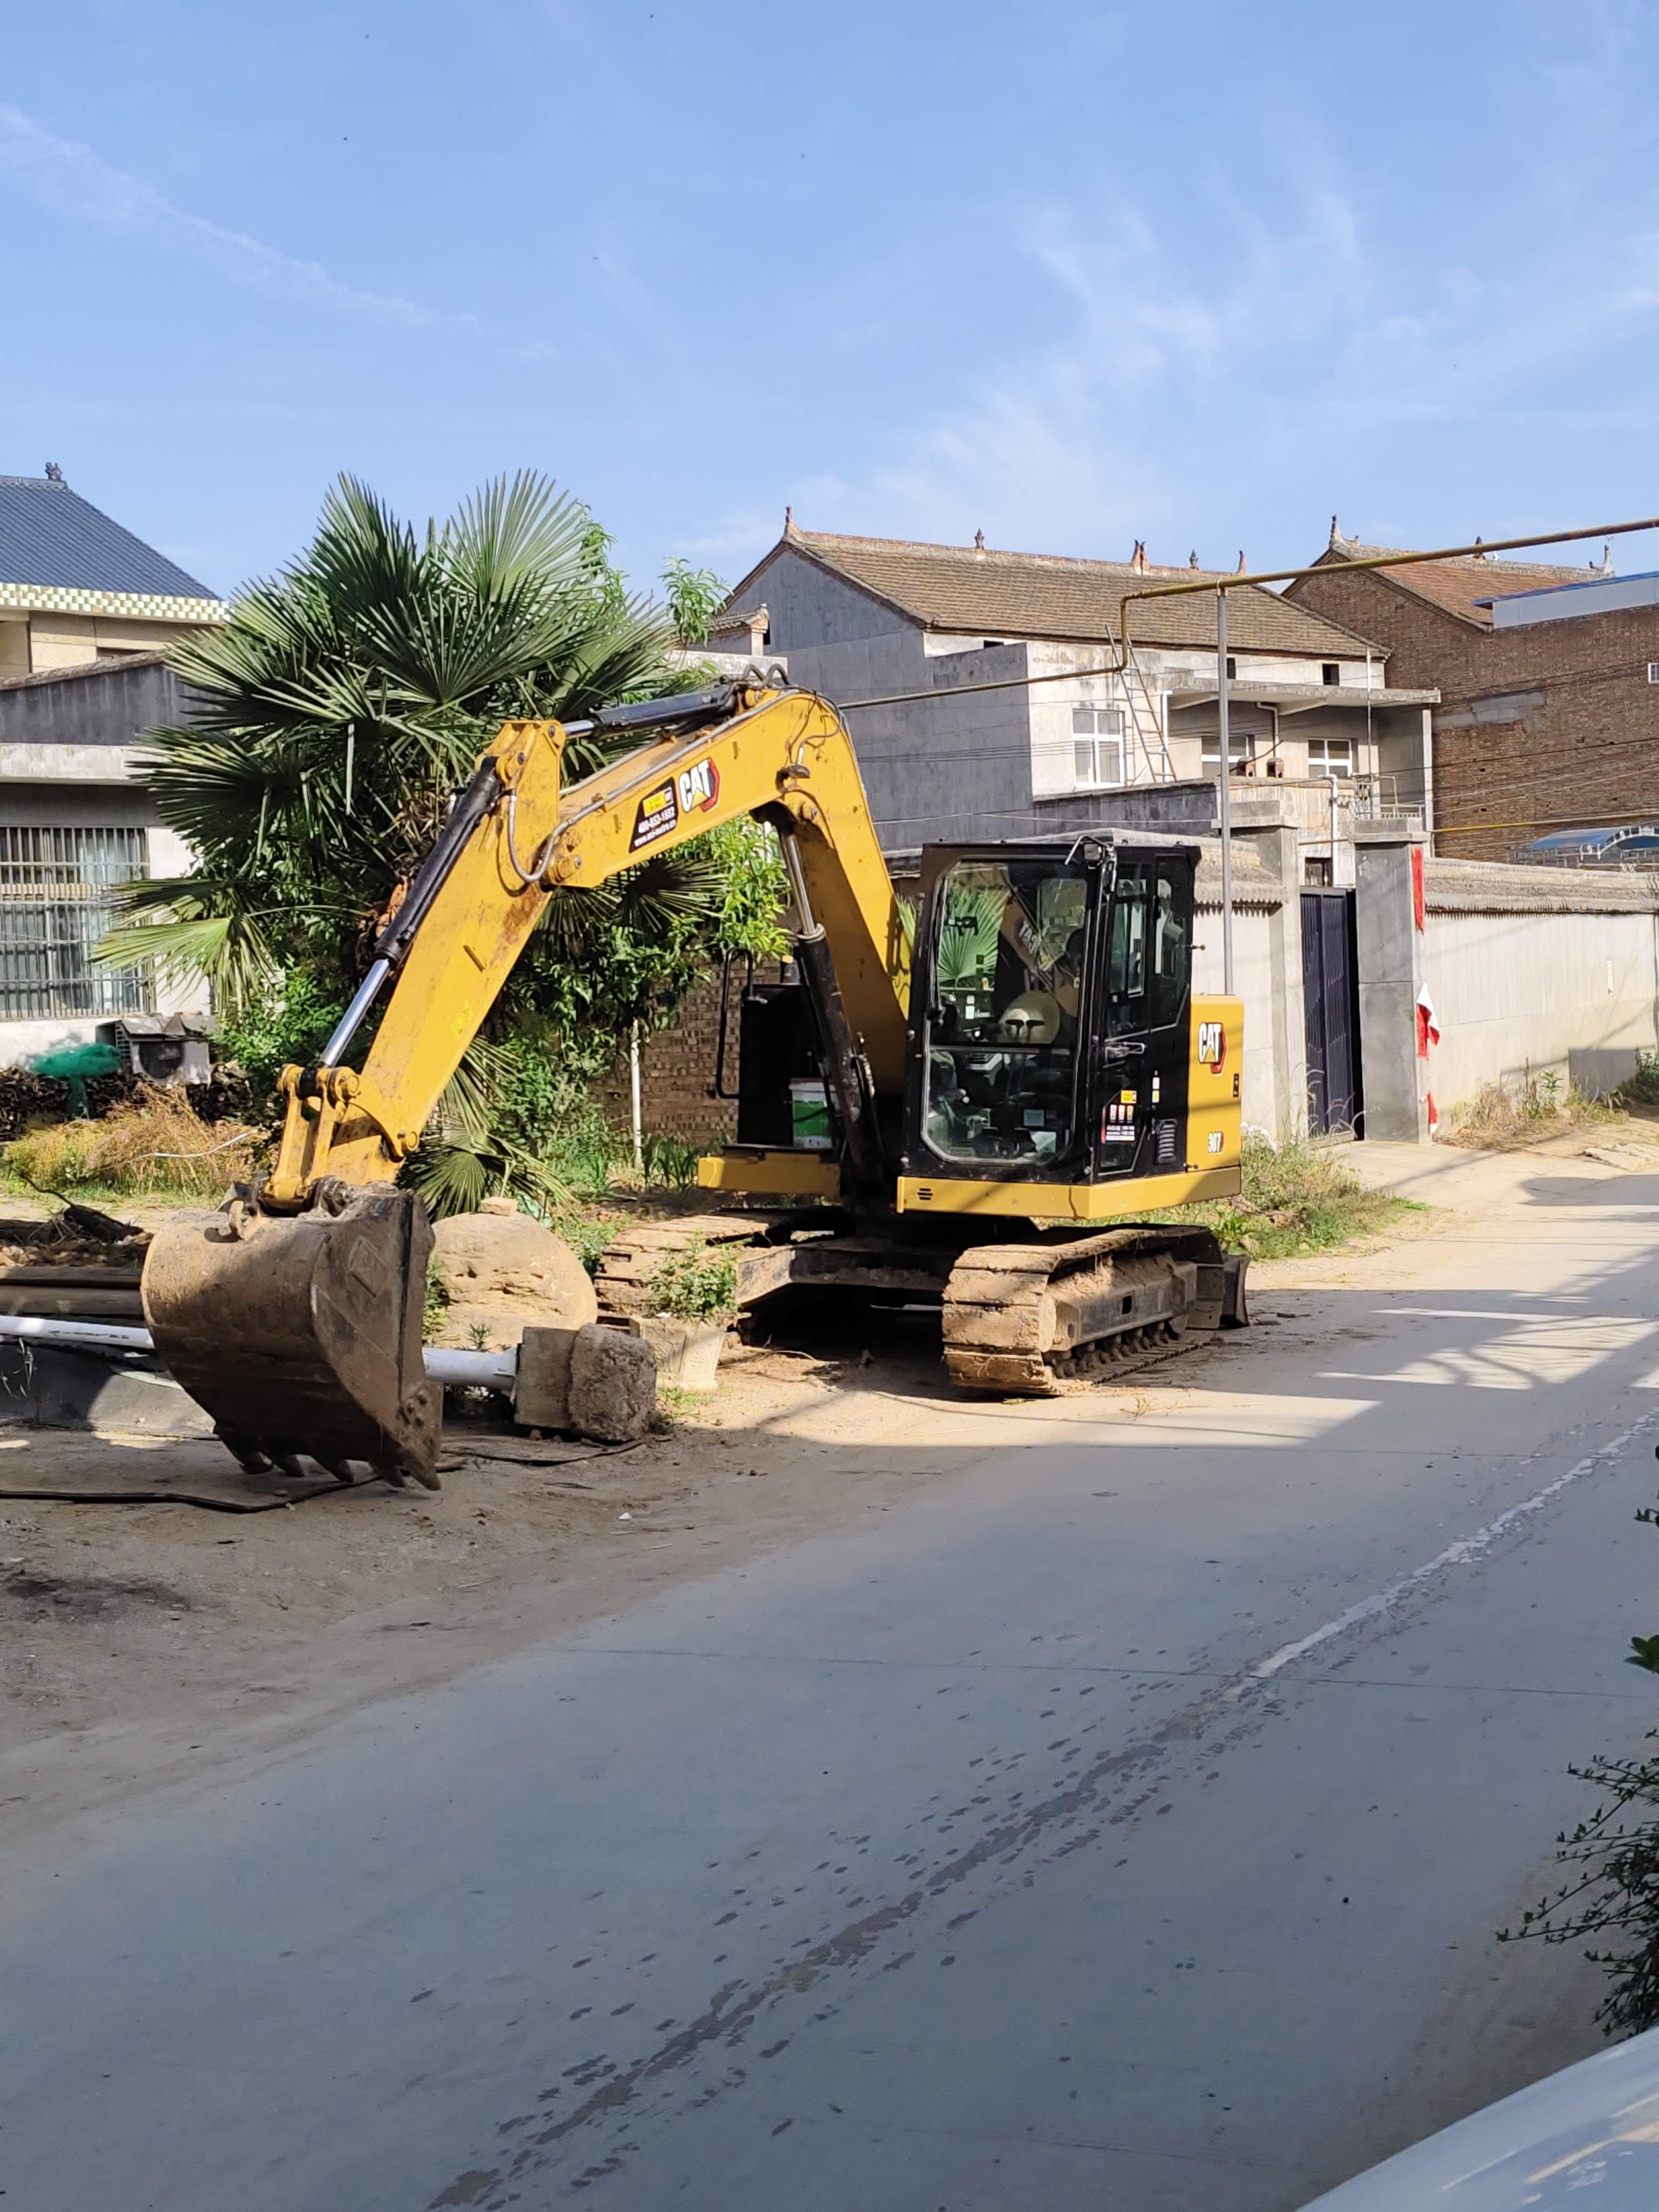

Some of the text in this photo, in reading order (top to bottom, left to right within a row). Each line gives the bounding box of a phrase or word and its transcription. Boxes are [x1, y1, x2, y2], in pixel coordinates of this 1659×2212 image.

[679, 759, 711, 813] CAT
[1198, 1022, 1222, 1063] CAT
[1208, 1131, 1222, 1154] 307
